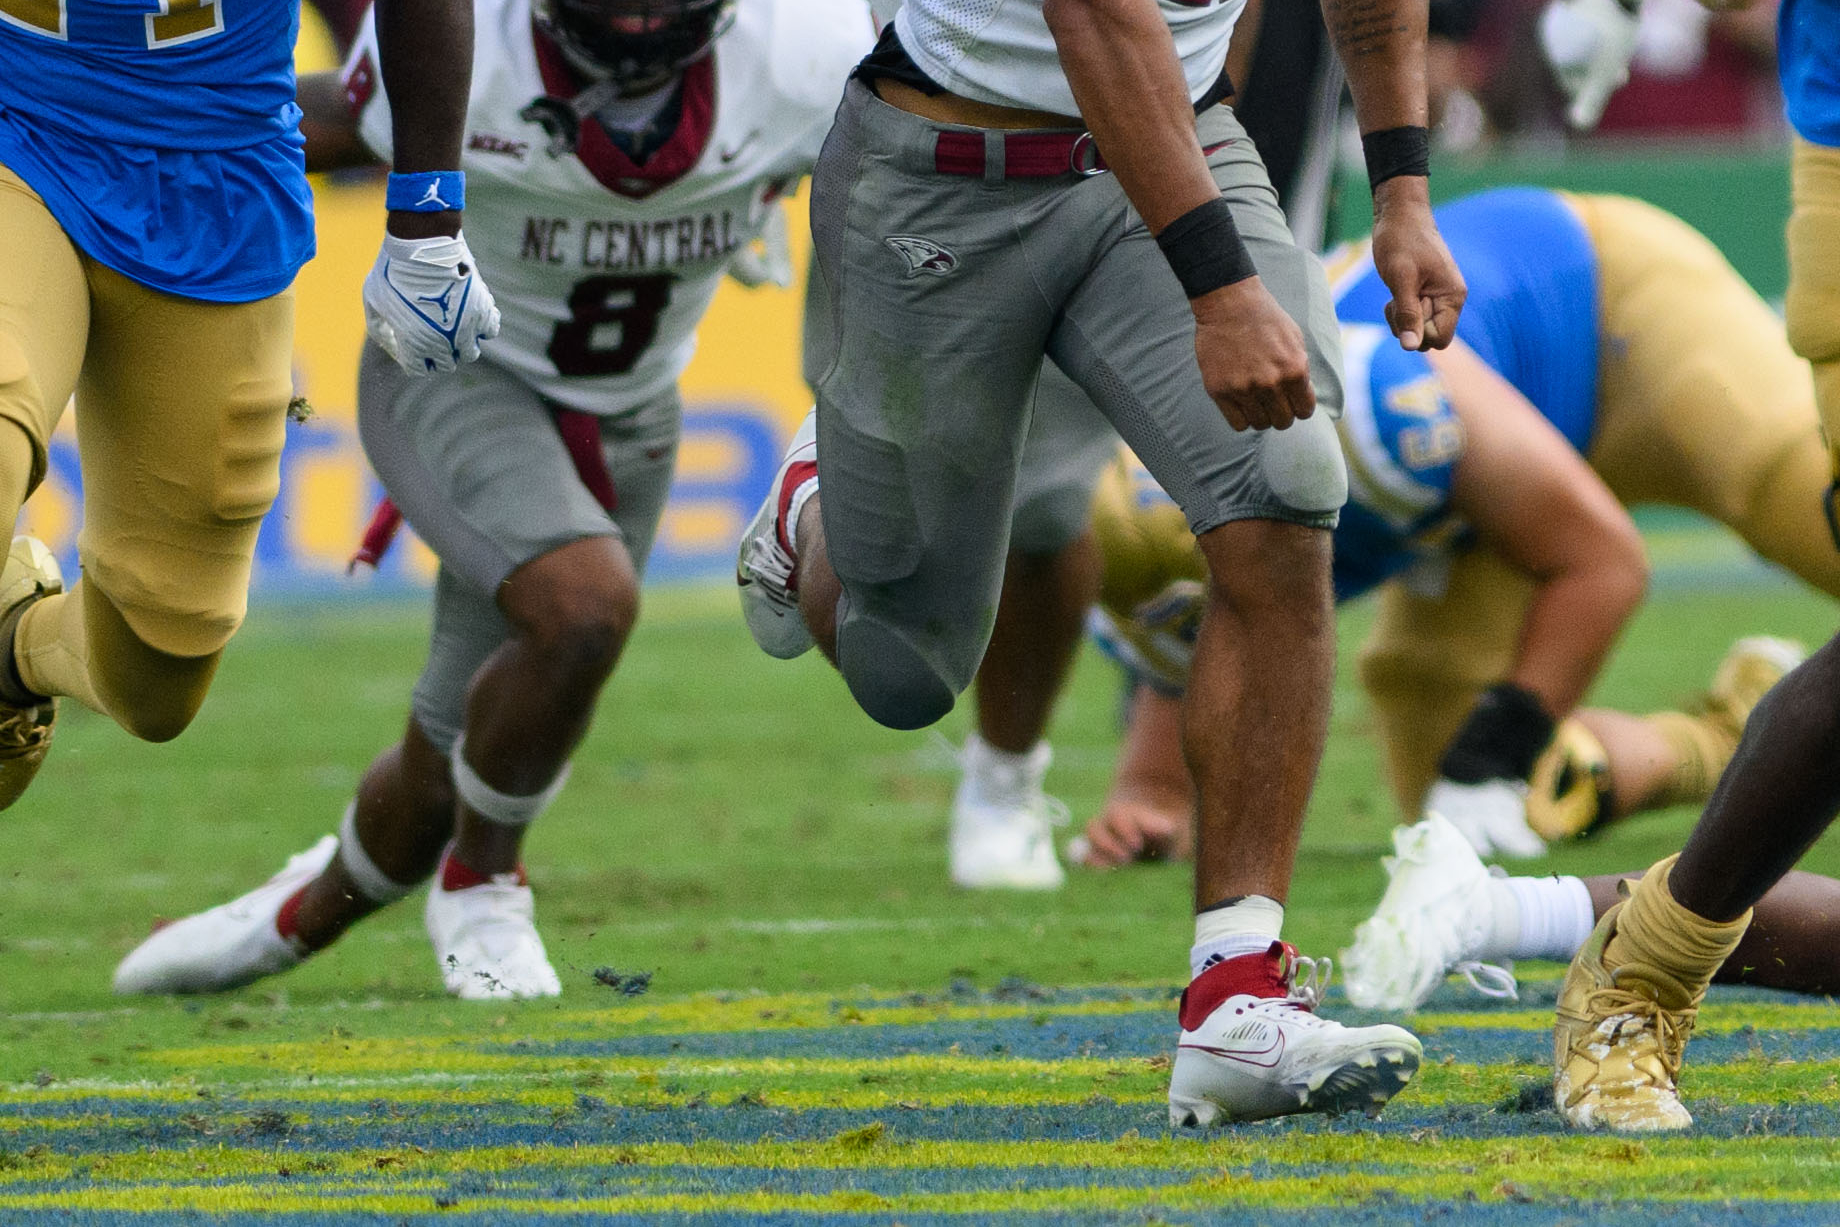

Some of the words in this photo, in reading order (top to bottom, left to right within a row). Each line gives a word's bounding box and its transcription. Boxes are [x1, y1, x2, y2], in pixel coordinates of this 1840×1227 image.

[521, 217, 571, 265] NC
[581, 208, 739, 269] CENTRAL
[549, 275, 678, 379] 8
